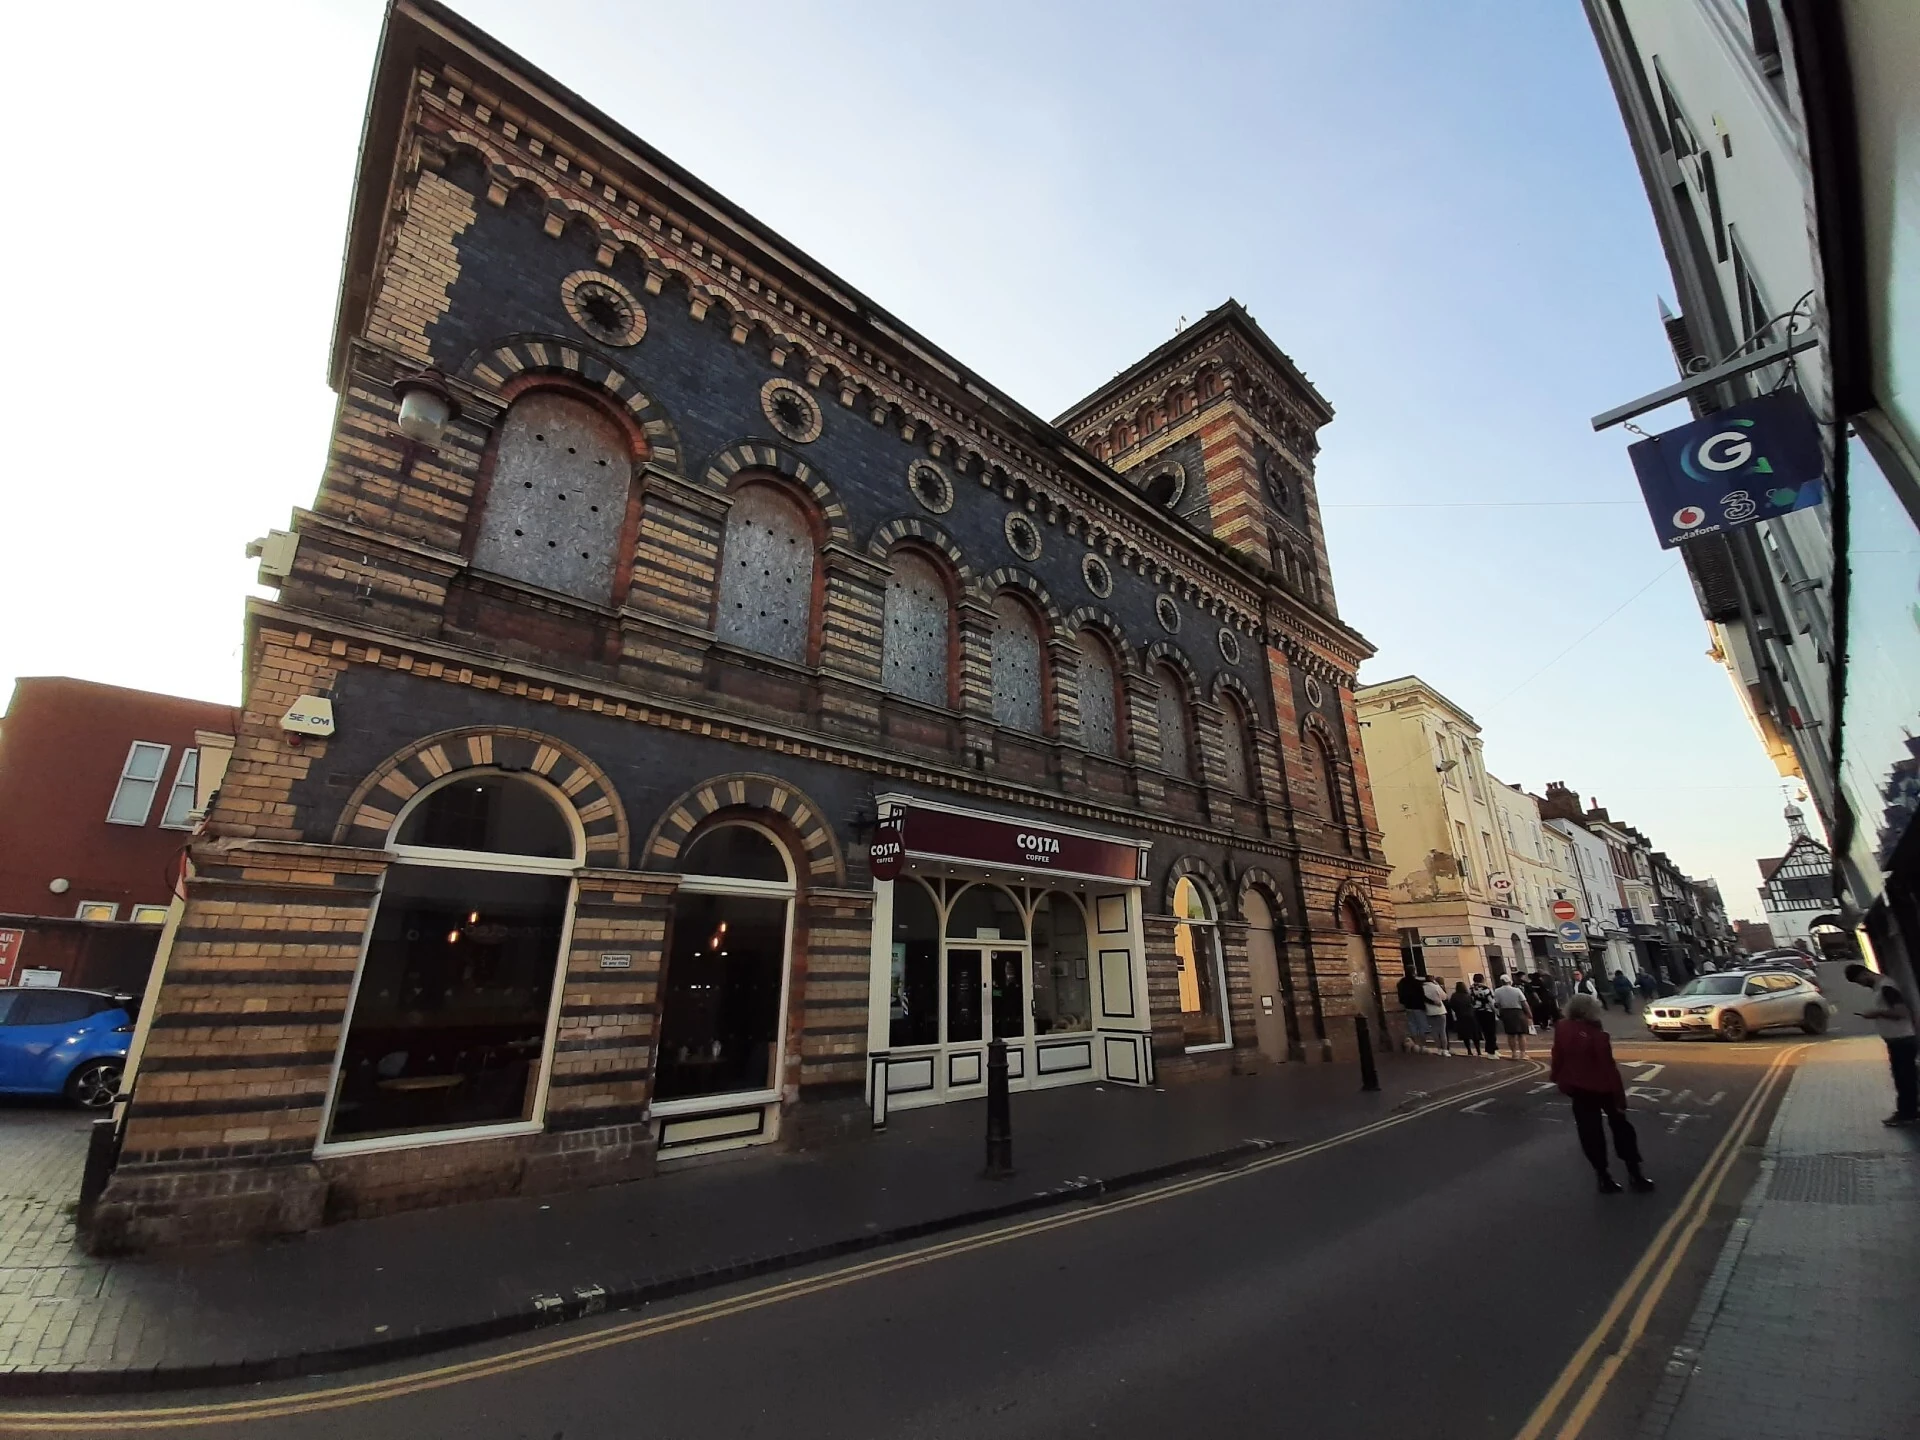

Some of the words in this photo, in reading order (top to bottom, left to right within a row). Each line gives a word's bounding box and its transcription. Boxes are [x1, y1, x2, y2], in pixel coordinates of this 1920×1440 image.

[1698, 431, 1752, 472] G
[1720, 490, 1756, 520] 3
[1669, 525, 1720, 543] vodafone
[289, 712, 330, 726] SEOM
[870, 842, 900, 856] COSTA
[1017, 834, 1060, 853] COSTA
[1026, 854, 1050, 863] COFFEE
